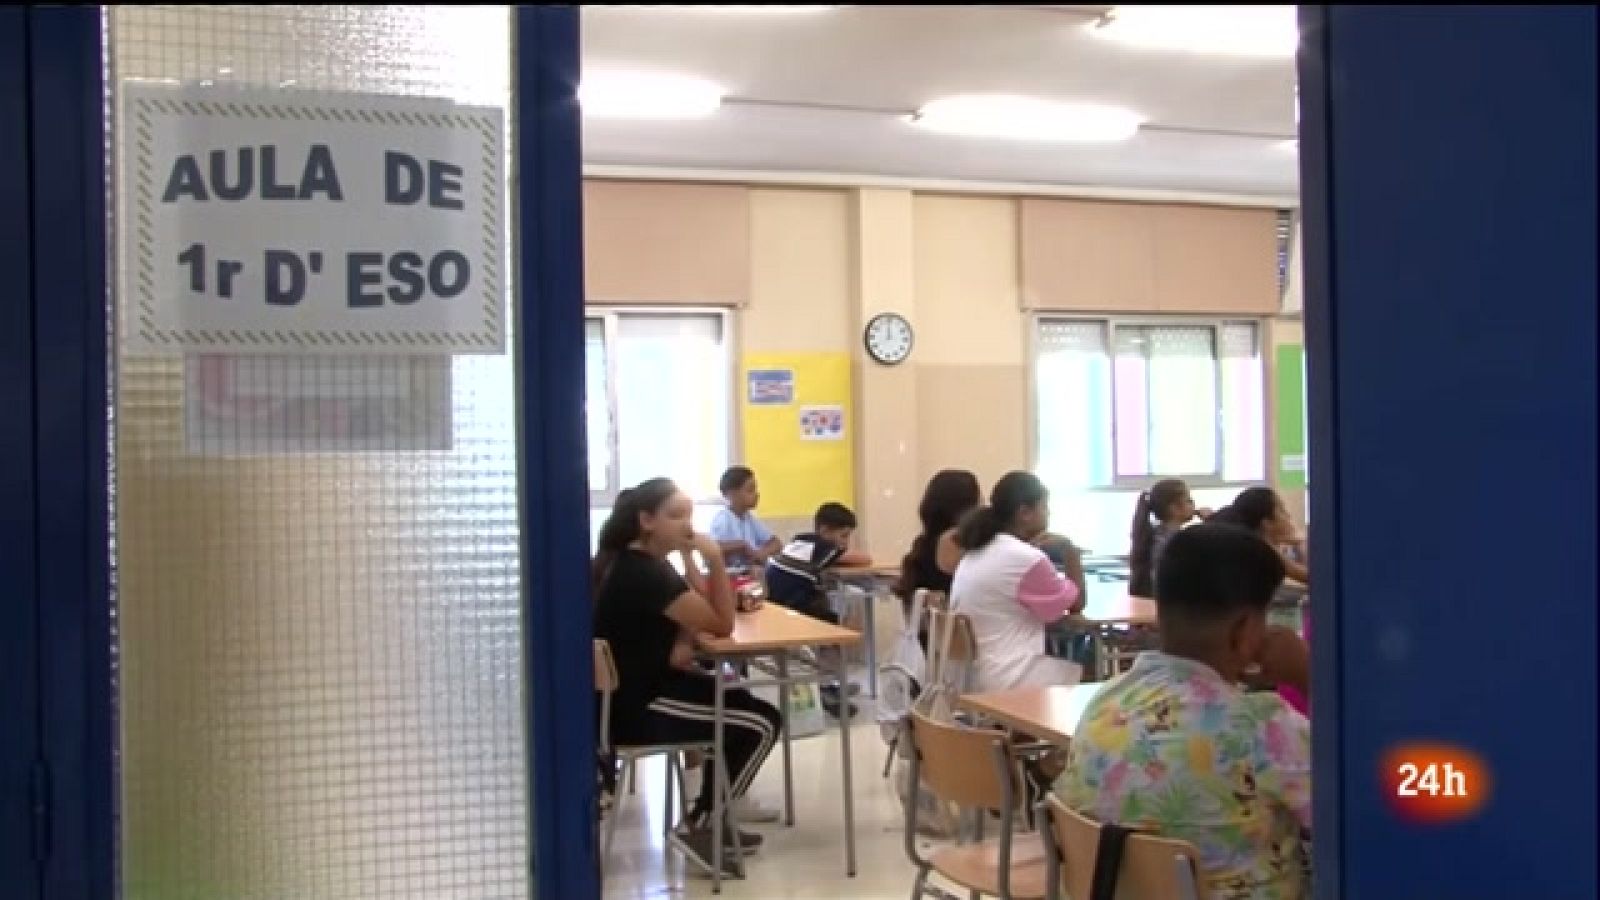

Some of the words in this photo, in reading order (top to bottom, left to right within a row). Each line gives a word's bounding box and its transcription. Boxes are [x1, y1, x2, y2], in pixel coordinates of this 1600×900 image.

[162, 143, 344, 203] AULA
[384, 149, 464, 211] DE
[176, 243, 243, 299] 1r
[264, 249, 324, 307] D'
[346, 249, 471, 309] ESO
